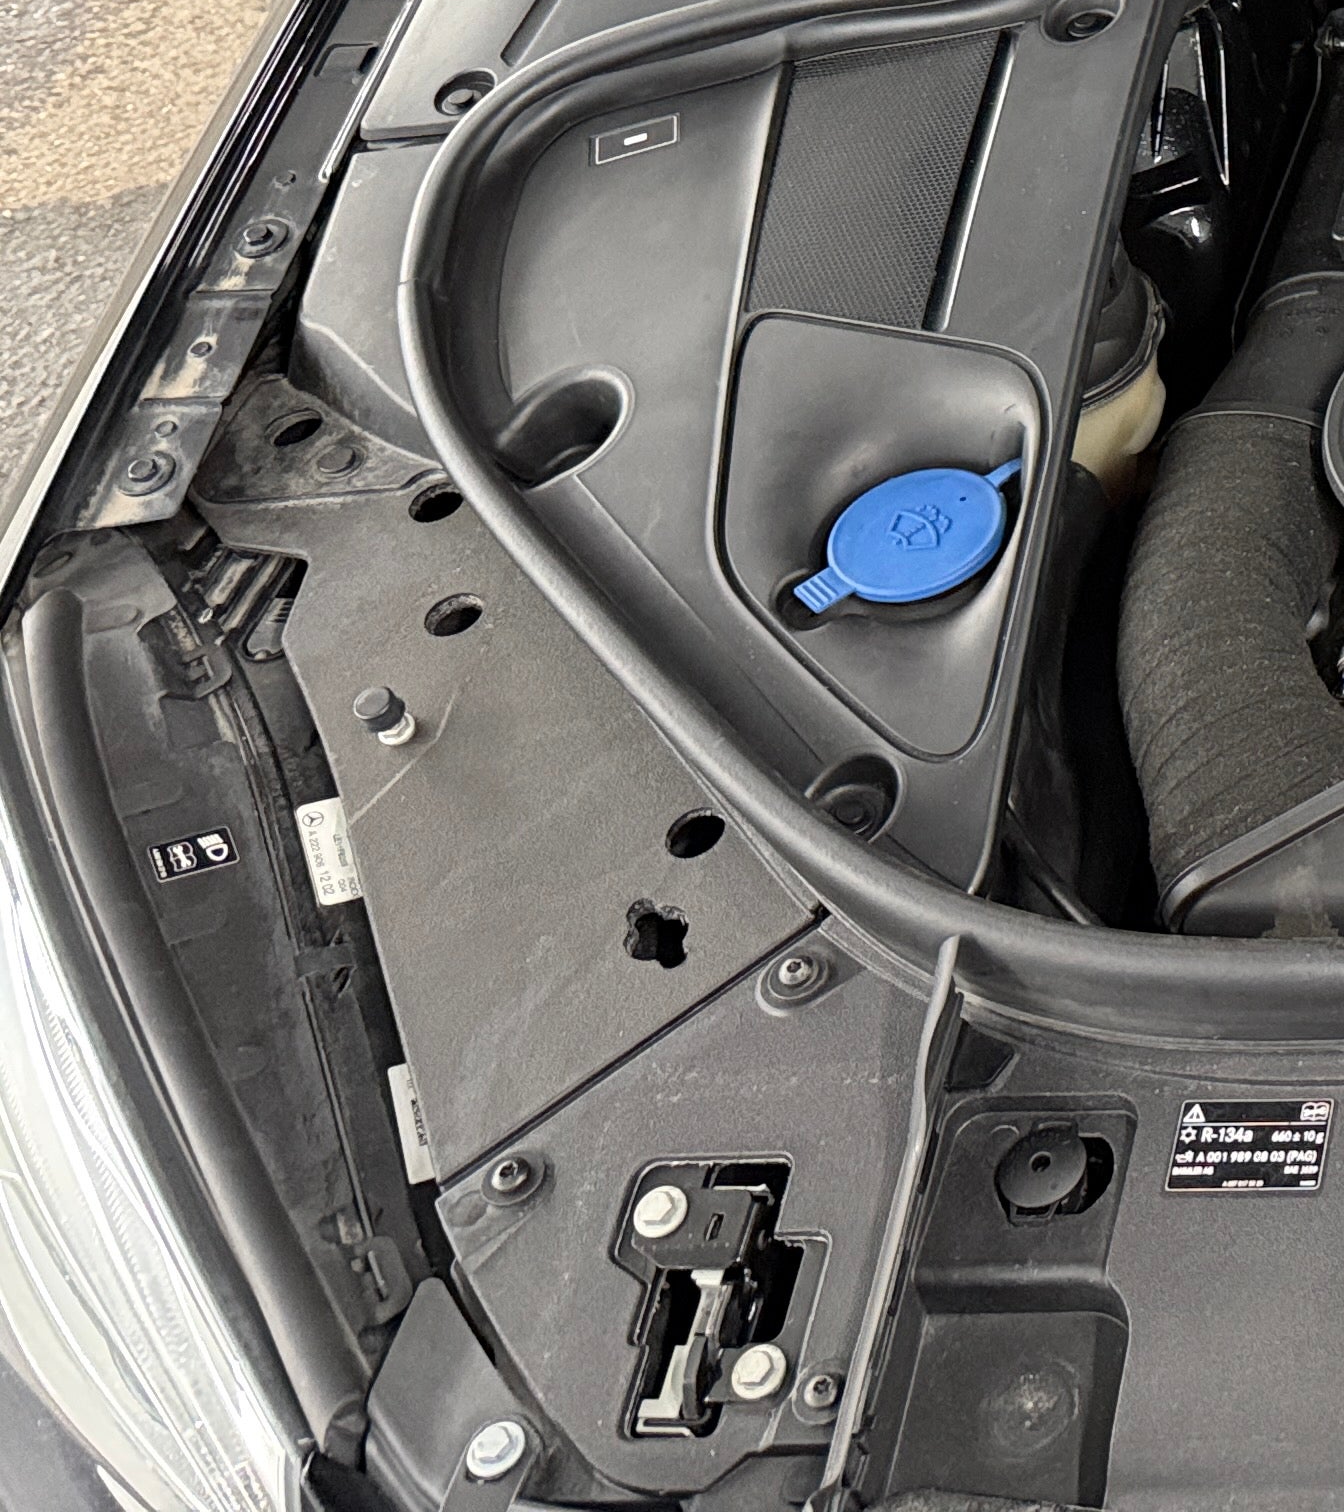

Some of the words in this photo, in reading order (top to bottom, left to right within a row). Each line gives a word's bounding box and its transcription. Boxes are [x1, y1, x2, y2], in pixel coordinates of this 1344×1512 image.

[1201, 1127, 1253, 1143] R-134a
[1303, 1130, 1315, 1142] 10
[1195, 1151, 1205, 1163] A
[1206, 1151, 1227, 1163] 001
[1286, 1150, 1317, 1164] (PAG)
